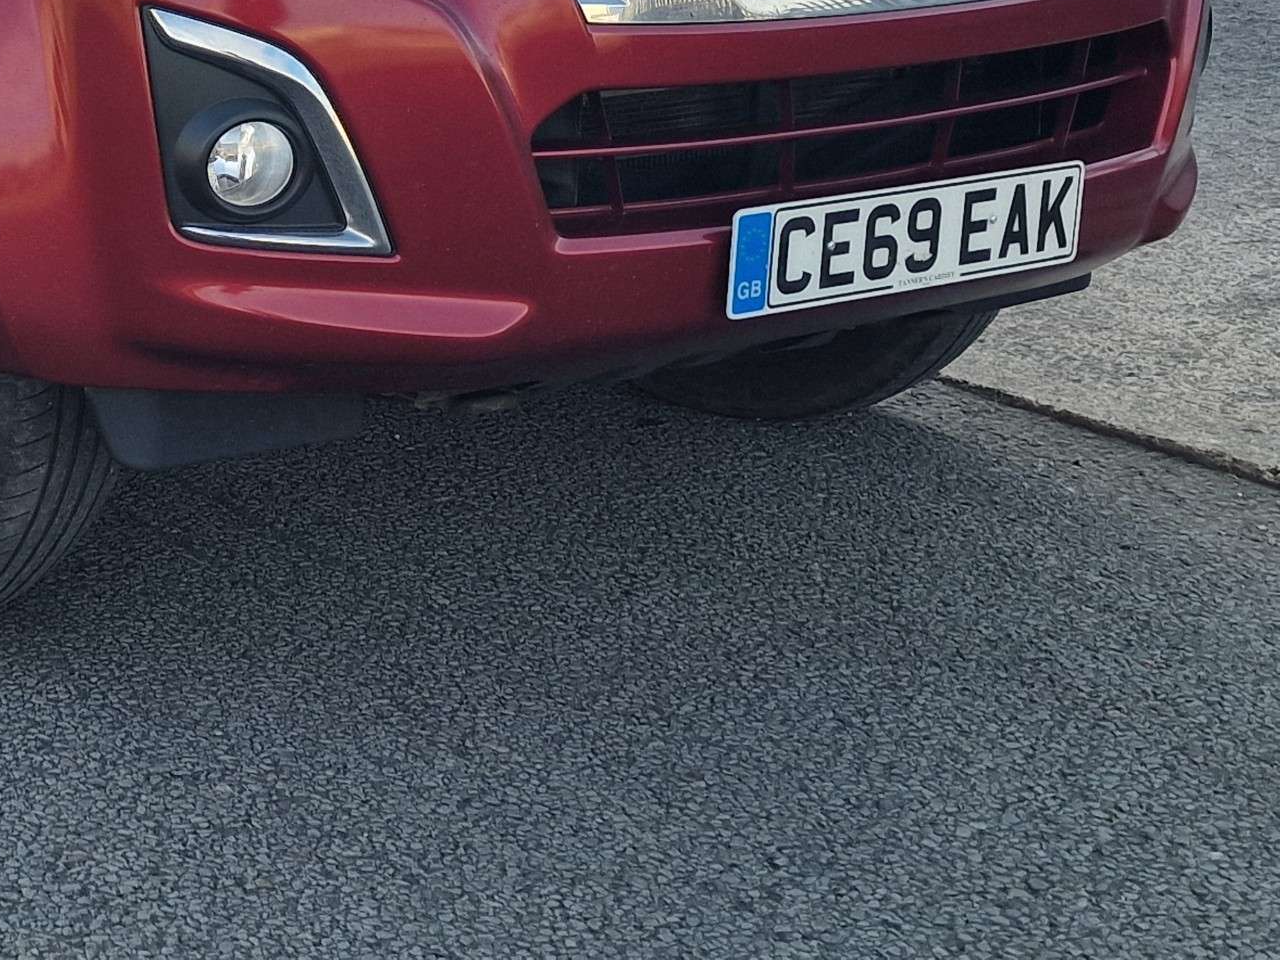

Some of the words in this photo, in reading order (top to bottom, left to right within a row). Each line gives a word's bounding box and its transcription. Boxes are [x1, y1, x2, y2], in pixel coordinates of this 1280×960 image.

[776, 197, 943, 295] CE69
[958, 175, 1074, 266] EAK
[737, 279, 762, 300] GB
